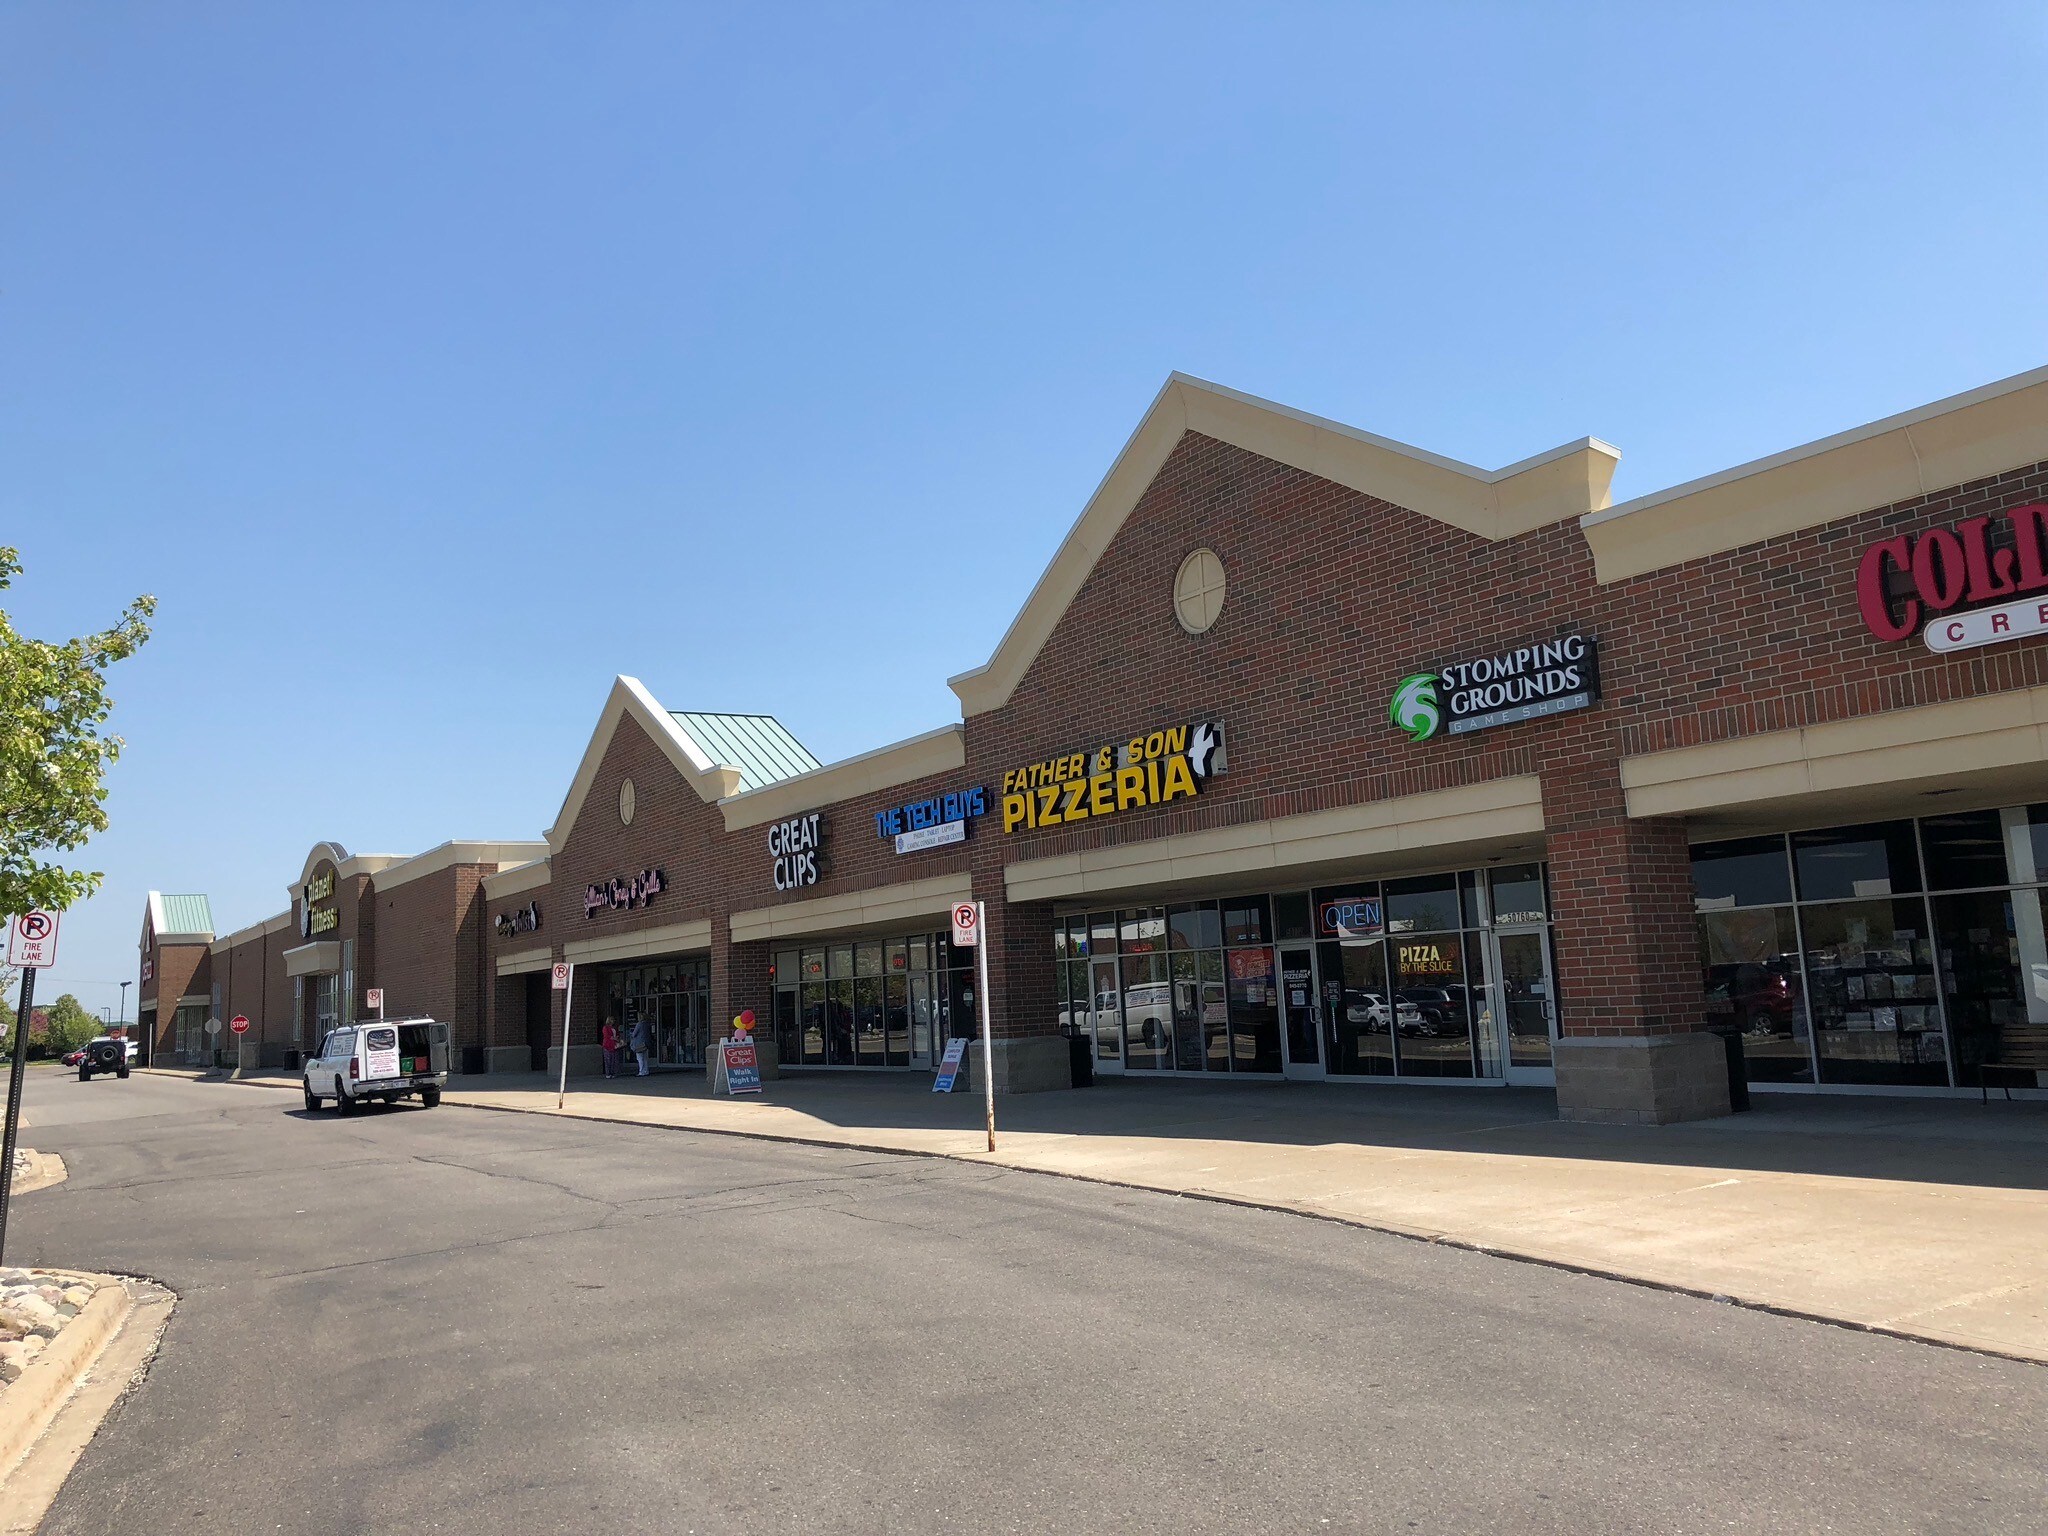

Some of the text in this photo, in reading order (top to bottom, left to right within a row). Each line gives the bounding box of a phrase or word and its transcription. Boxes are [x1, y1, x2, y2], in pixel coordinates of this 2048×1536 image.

[1442, 635, 1585, 690] STOMPING
[1451, 665, 1580, 714] GROUNDS
[1454, 695, 1583, 731] GAME SHOP
[1003, 725, 1186, 794] FATHER & SON
[1003, 755, 1197, 834] PIZZERIA
[875, 787, 984, 838] THE TECH GUYS
[768, 813, 820, 857] GREAT
[774, 850, 817, 891] CLIPS
[1326, 902, 1380, 928] OPEN
[21, 952, 43, 961] LANE
[24, 942, 42, 951] FIRE
[1400, 945, 1440, 963] PIZZA
[1400, 960, 1452, 972] BY THE SLICE
[232, 1020, 248, 1029] STOP
[726, 1048, 752, 1057] Great
[730, 1056, 752, 1066] Clips
[730, 1077, 750, 1085] Right
